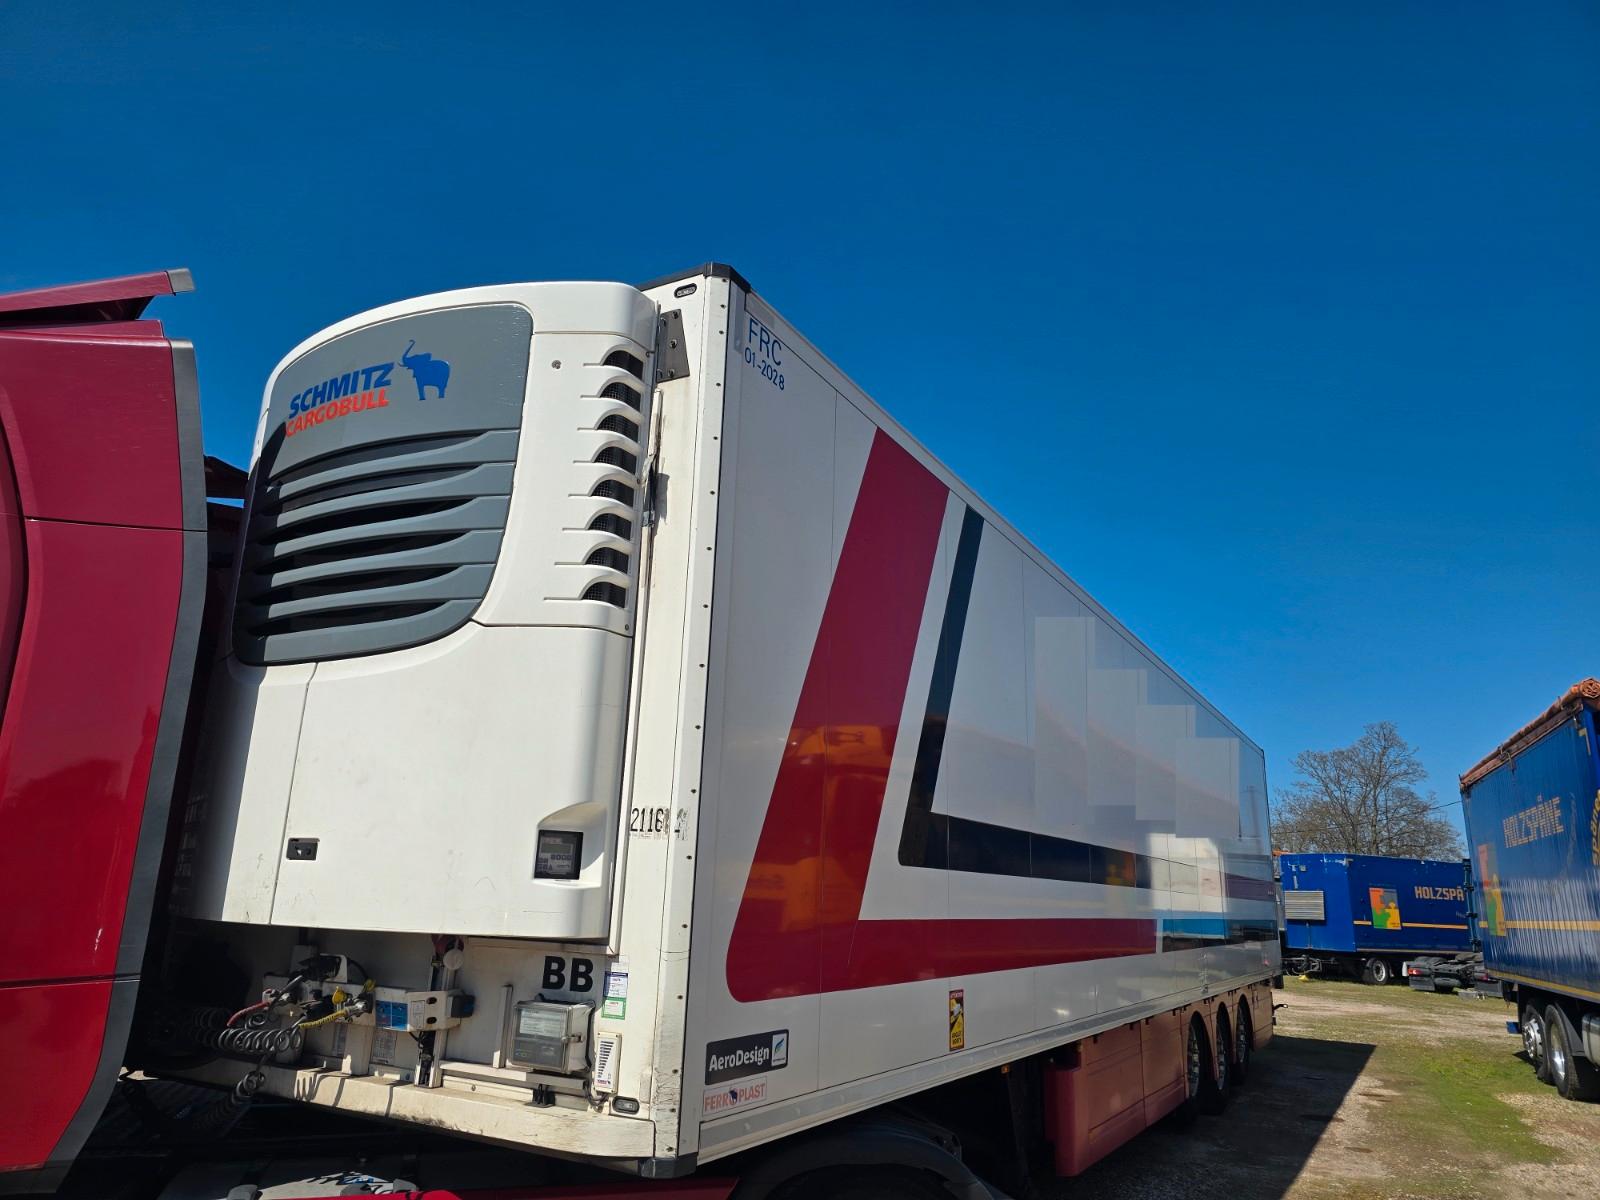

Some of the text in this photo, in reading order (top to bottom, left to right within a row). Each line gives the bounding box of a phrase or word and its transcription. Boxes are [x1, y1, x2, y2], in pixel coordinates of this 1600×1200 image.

[748, 318, 782, 366] FRC
[288, 361, 395, 419] SCHMITZ
[744, 347, 785, 391] 01-2028
[285, 388, 389, 438] CARGOBULL
[542, 955, 594, 993] BB
[708, 1045, 770, 1072] AeroDesign
